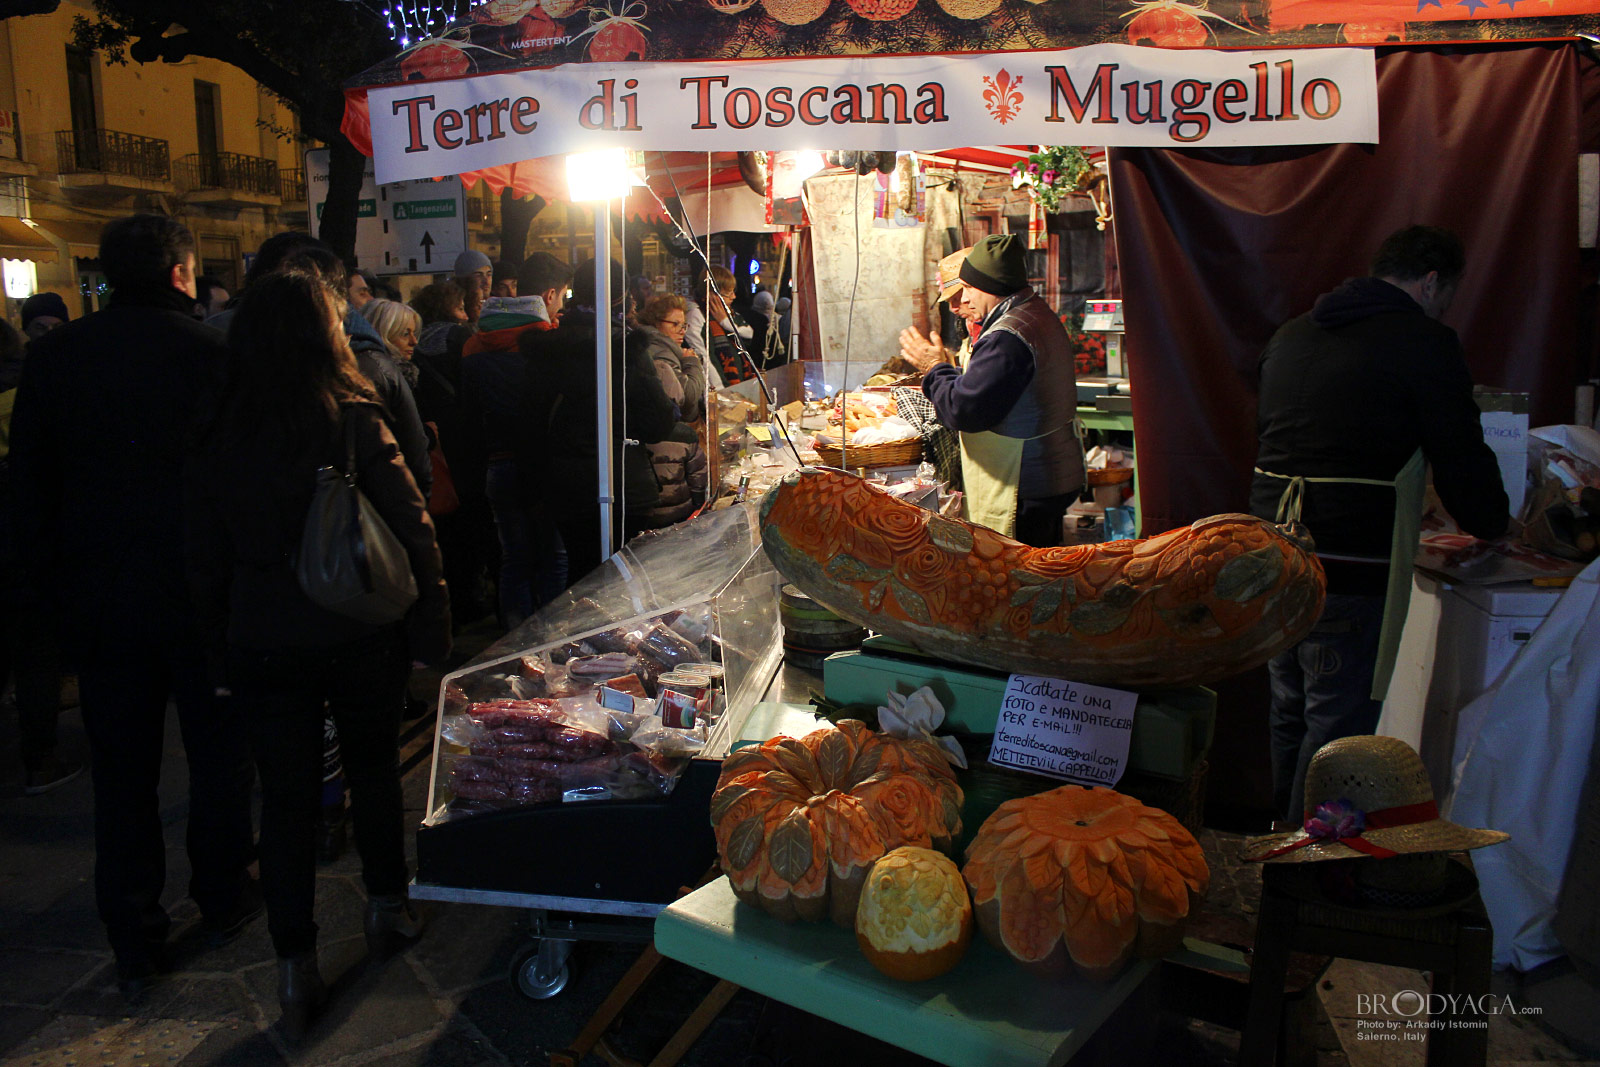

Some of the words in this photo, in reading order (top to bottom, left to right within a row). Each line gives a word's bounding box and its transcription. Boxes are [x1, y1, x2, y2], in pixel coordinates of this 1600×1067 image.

[511, 36, 572, 50] MASTERTENT
[392, 95, 540, 153] Terre
[578, 78, 643, 131] di
[680, 75, 949, 129] Toscana
[1044, 59, 1342, 142] Mugello
[411, 203, 454, 215] Tangenziale
[1010, 675, 1077, 702] Scattate
[1005, 695, 1035, 711] FOTO
[1002, 711, 1027, 726] PER
